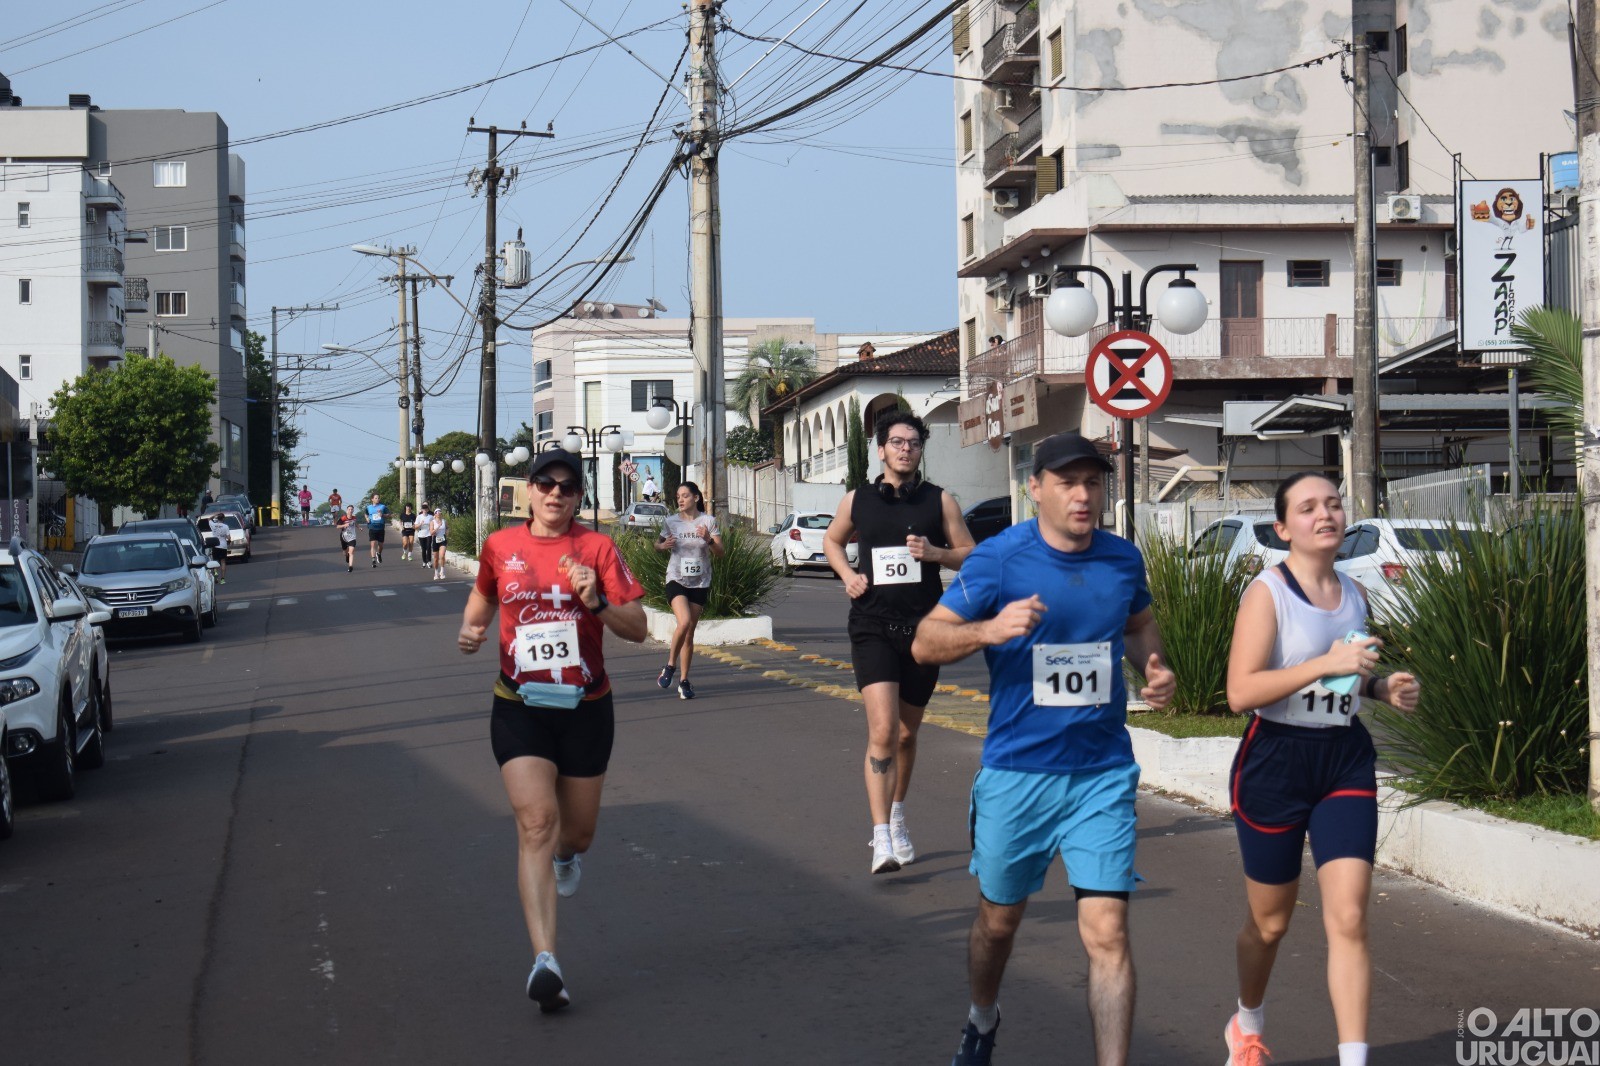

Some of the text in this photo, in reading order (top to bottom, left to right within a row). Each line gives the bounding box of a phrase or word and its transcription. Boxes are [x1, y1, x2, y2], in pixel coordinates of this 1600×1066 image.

[1491, 253, 1517, 336] ZAAP
[684, 566, 701, 574] 152
[885, 563, 908, 577] 50
[501, 582, 537, 604] Sou
[519, 603, 583, 624] Corrida
[527, 641, 569, 662] 193
[1046, 670, 1097, 694] 101
[1302, 690, 1352, 715] 118
